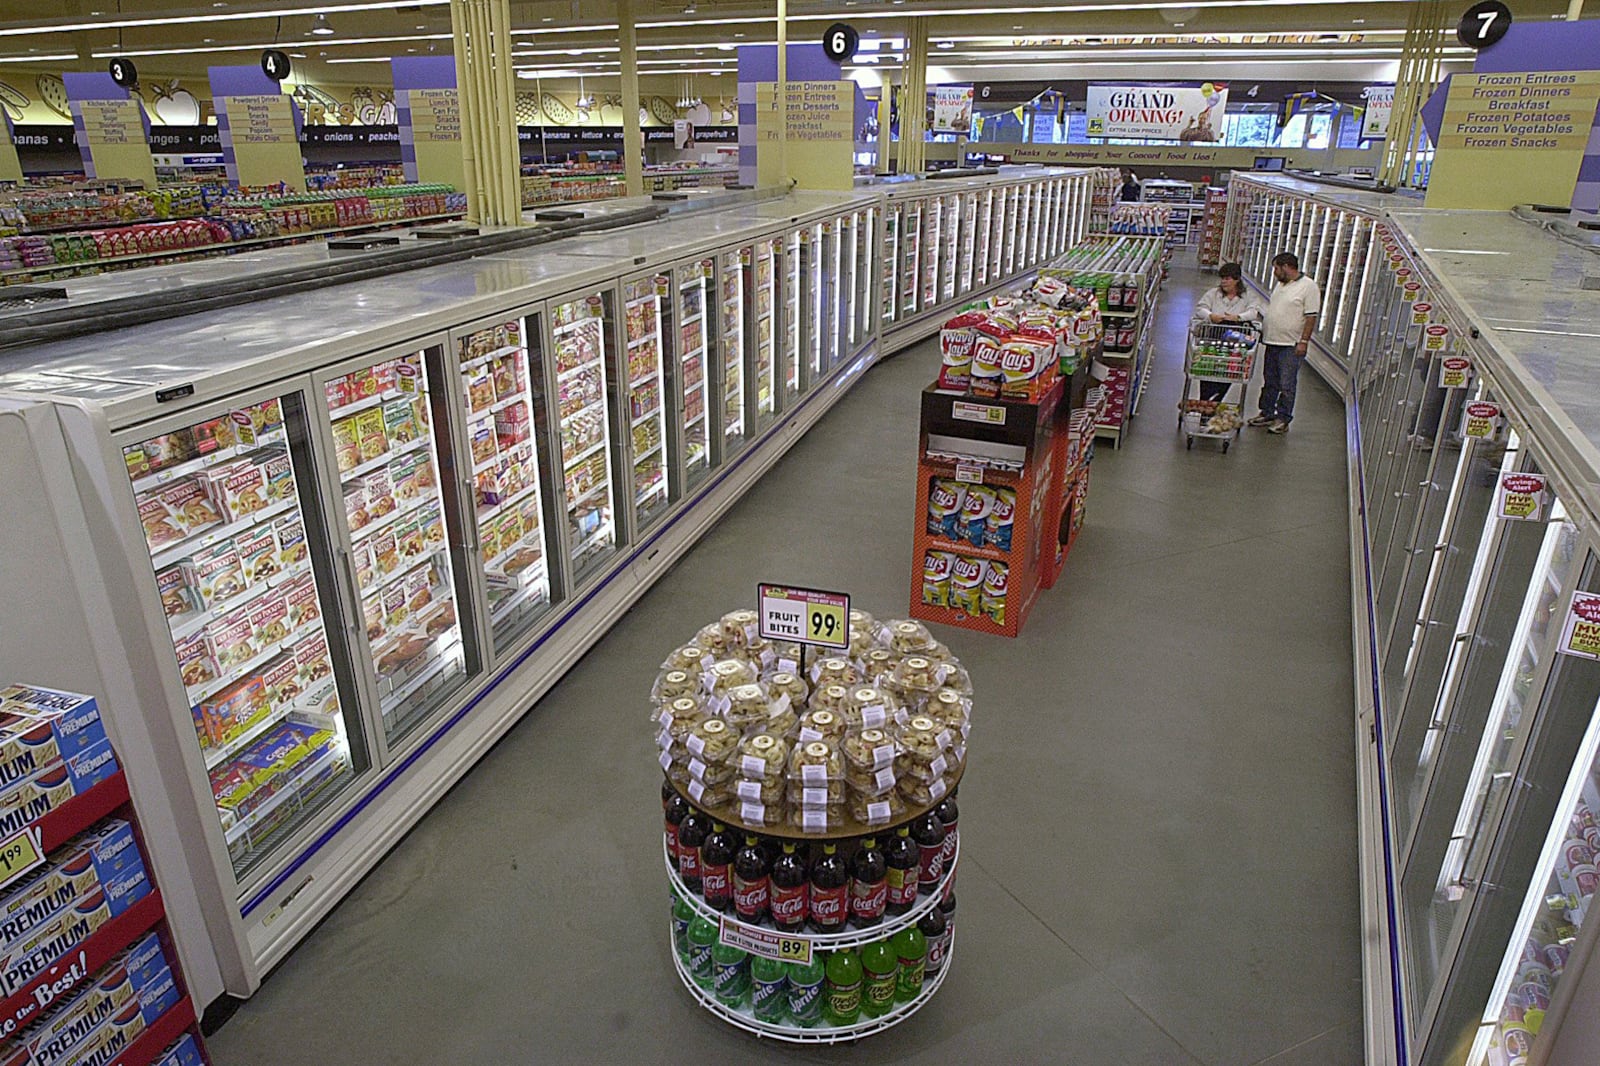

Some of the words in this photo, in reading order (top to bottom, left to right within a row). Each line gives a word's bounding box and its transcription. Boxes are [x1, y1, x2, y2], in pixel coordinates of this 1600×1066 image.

[1477, 11, 1498, 39] 7
[832, 32, 846, 54] 6
[266, 56, 276, 73] 4
[113, 64, 123, 80] 3
[1478, 75, 1521, 85] Frozen
[1525, 73, 1576, 83] Entrees
[774, 83, 802, 91] Fzen
[804, 82, 837, 91] Dinners
[981, 86, 991, 98] 6
[1247, 85, 1259, 97] 4
[1359, 86, 1371, 99] 3
[1472, 88, 1516, 98] Frozen
[1520, 87, 1571, 97] Dinners
[774, 93, 802, 101] Fzen
[804, 93, 836, 101] Entrees
[1110, 91, 1175, 109] GRAND
[1369, 94, 1394, 102] GRAN
[433, 107, 446, 115] Can
[803, 103, 840, 111] Desserts
[1488, 100, 1550, 110] Breakfast
[808, 112, 830, 120] Juice
[1108, 108, 1184, 126] OPENING!
[1466, 112, 1509, 122] Frozen
[1513, 112, 1571, 122] Potatoes
[696, 130, 728, 140] grapefruit
[798, 129, 842, 140] Vegetables
[1456, 124, 1499, 134] Frozen
[1503, 124, 1573, 135] Vegetables
[323, 132, 353, 141] onions
[1464, 137, 1506, 147] Frozen
[1510, 137, 1557, 147] Snacks
[1013, 149, 1040, 158] Thanks
[1047, 149, 1059, 158] for
[1065, 149, 1099, 160] shopping
[1128, 151, 1161, 161] Concord
[1166, 152, 1187, 161] Food
[769, 611, 800, 622] FRUIT
[769, 624, 799, 634] BITES
[60, 709, 100, 738] PREMIUM
[74, 750, 114, 780] PREMIUM
[98, 834, 134, 865] PREMIUM
[110, 871, 145, 901] PREMIUM
[0, 881, 76, 944] REMIUM
[5, 917, 91, 991] PREMIUM
[126, 943, 161, 976] PREMIUM
[16, 1002, 37, 1020] the
[31, 951, 88, 1009] Best!
[140, 977, 175, 1010] PREMIUM
[789, 985, 819, 1013] Sprite
[35, 996, 115, 1066] PREMIUM
